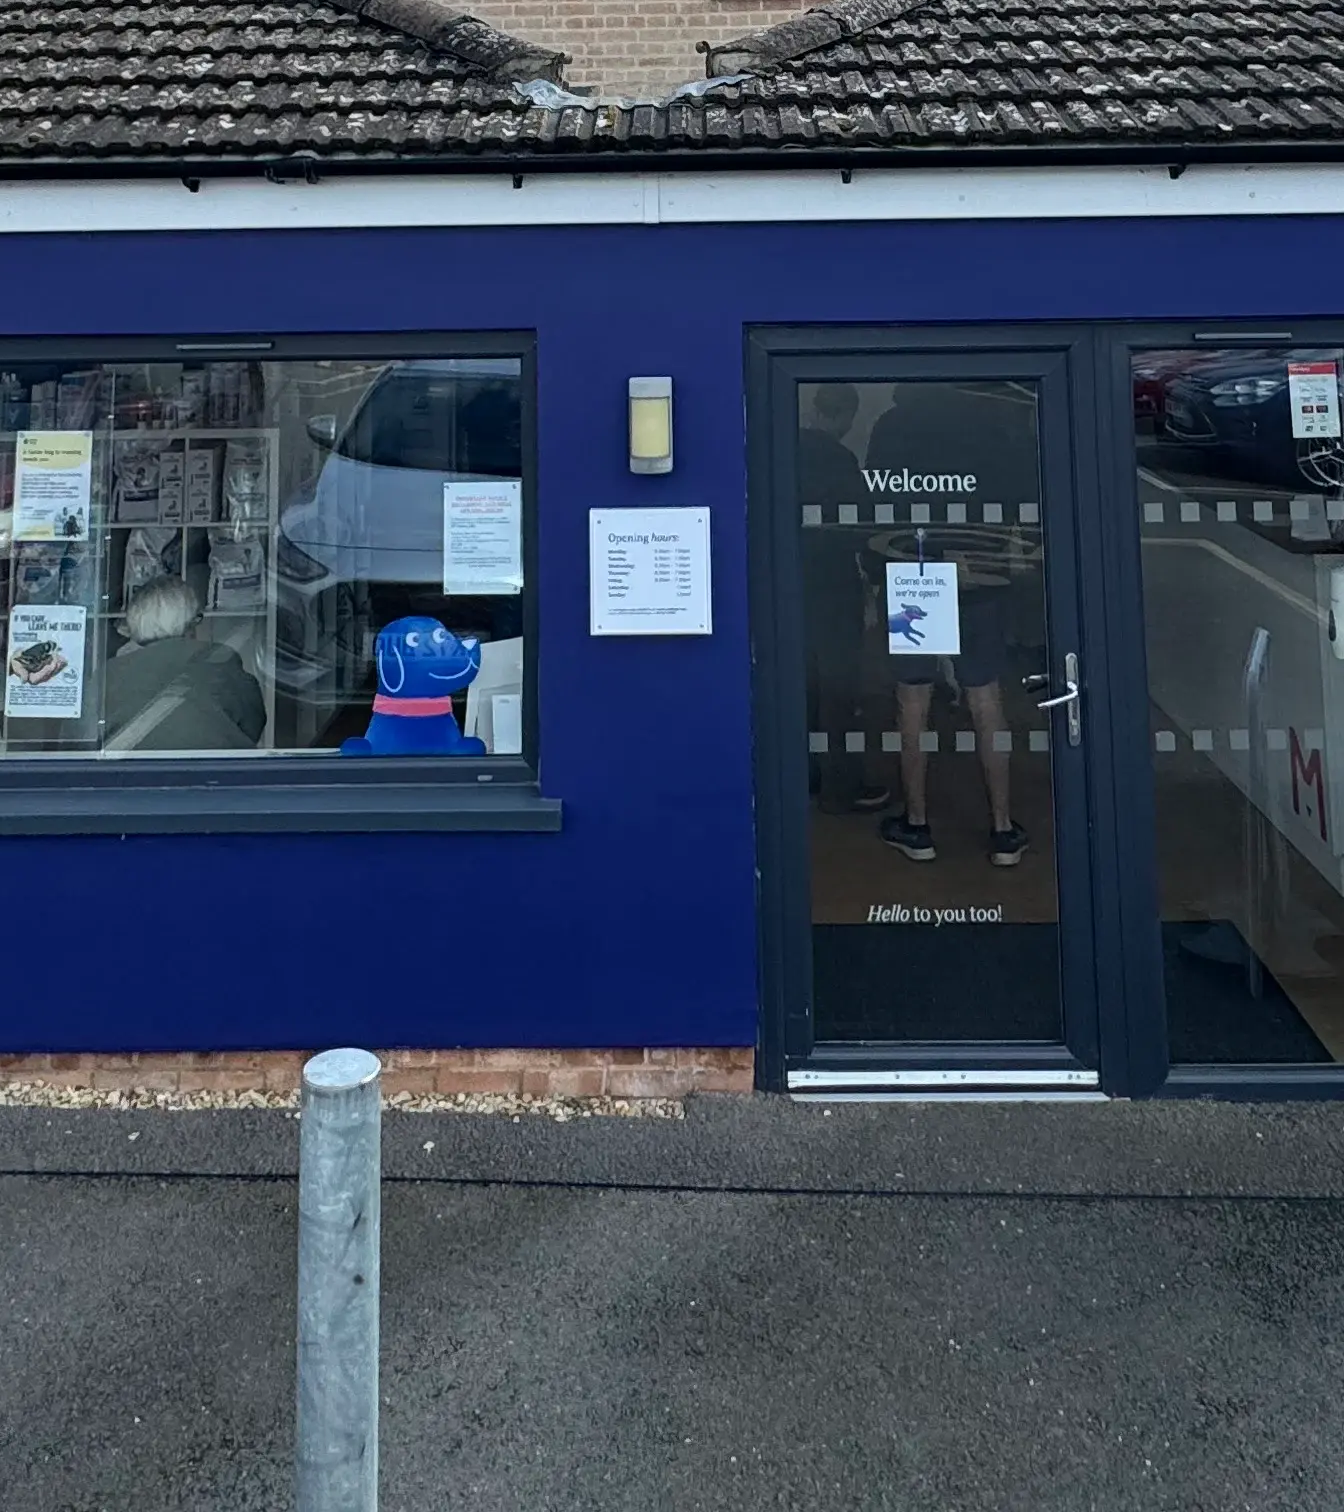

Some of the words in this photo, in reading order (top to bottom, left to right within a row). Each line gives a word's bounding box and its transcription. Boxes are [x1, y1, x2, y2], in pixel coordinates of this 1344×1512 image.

[861, 468, 977, 492] Welcome
[608, 533, 649, 545] Opening
[895, 576, 919, 585] Come
[895, 589, 917, 597] we're
[919, 590, 939, 600] open
[1289, 726, 1327, 842] M
[867, 904, 909, 923] Hello
[913, 906, 931, 923] to
[933, 908, 966, 927] you
[969, 904, 1002, 923] too!
